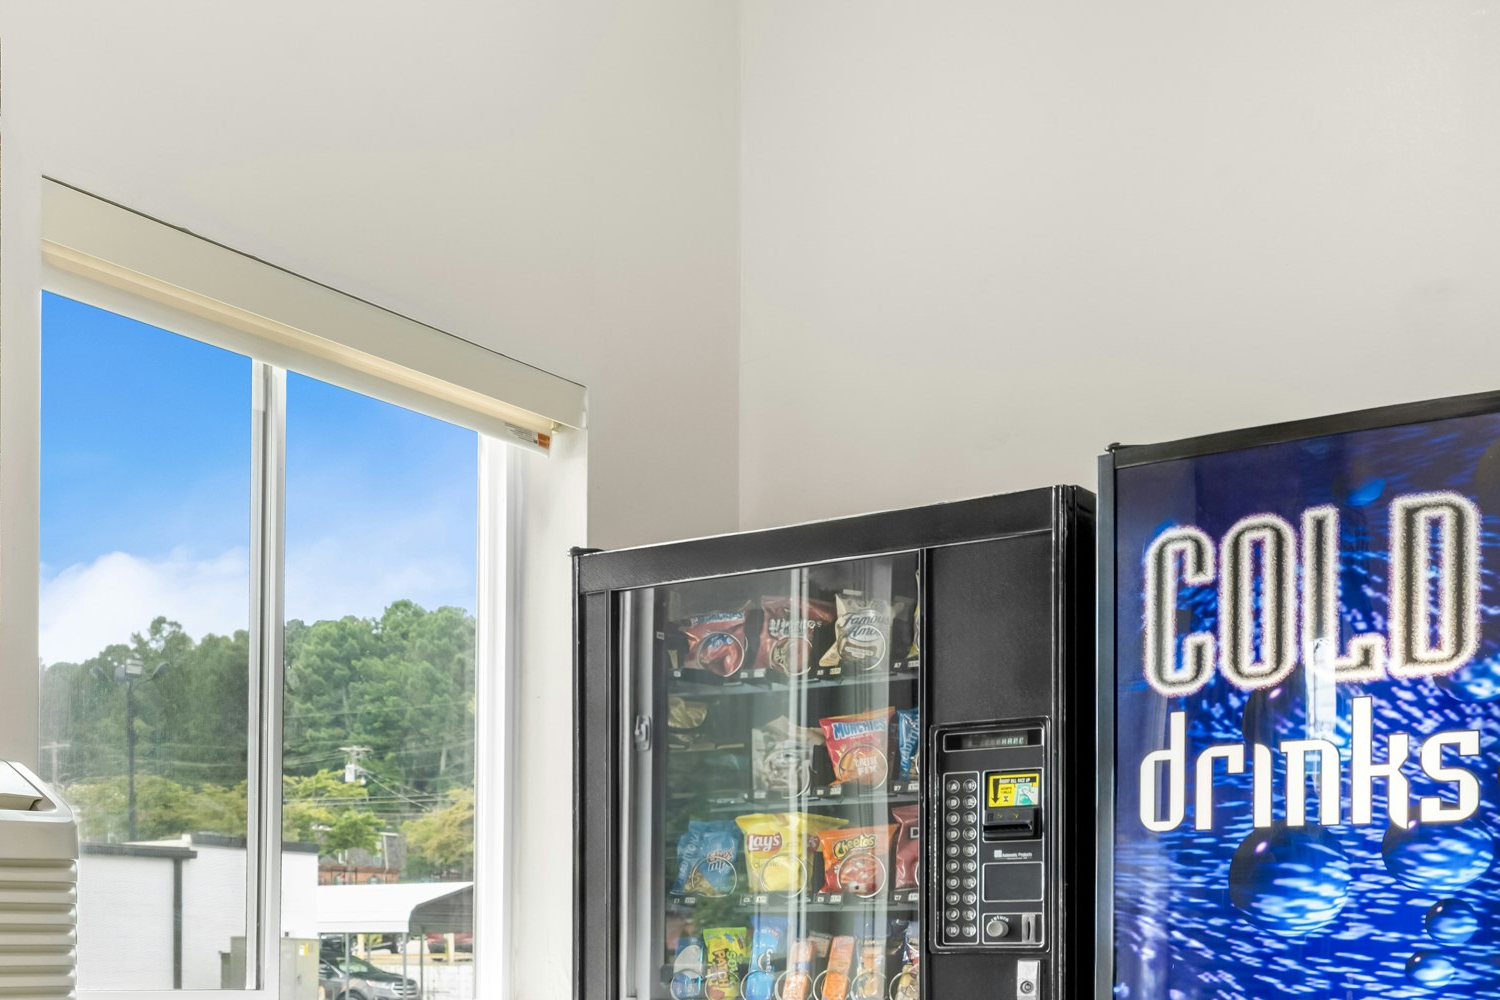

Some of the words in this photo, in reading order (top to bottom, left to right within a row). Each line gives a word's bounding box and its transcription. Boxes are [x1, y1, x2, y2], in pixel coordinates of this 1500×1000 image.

[1143, 490, 1484, 698] COLD
[832, 718, 887, 740] MUNCHIES
[1139, 695, 1481, 833] drinks
[748, 832, 781, 851] Lay's
[833, 833, 877, 859] Cheetos
